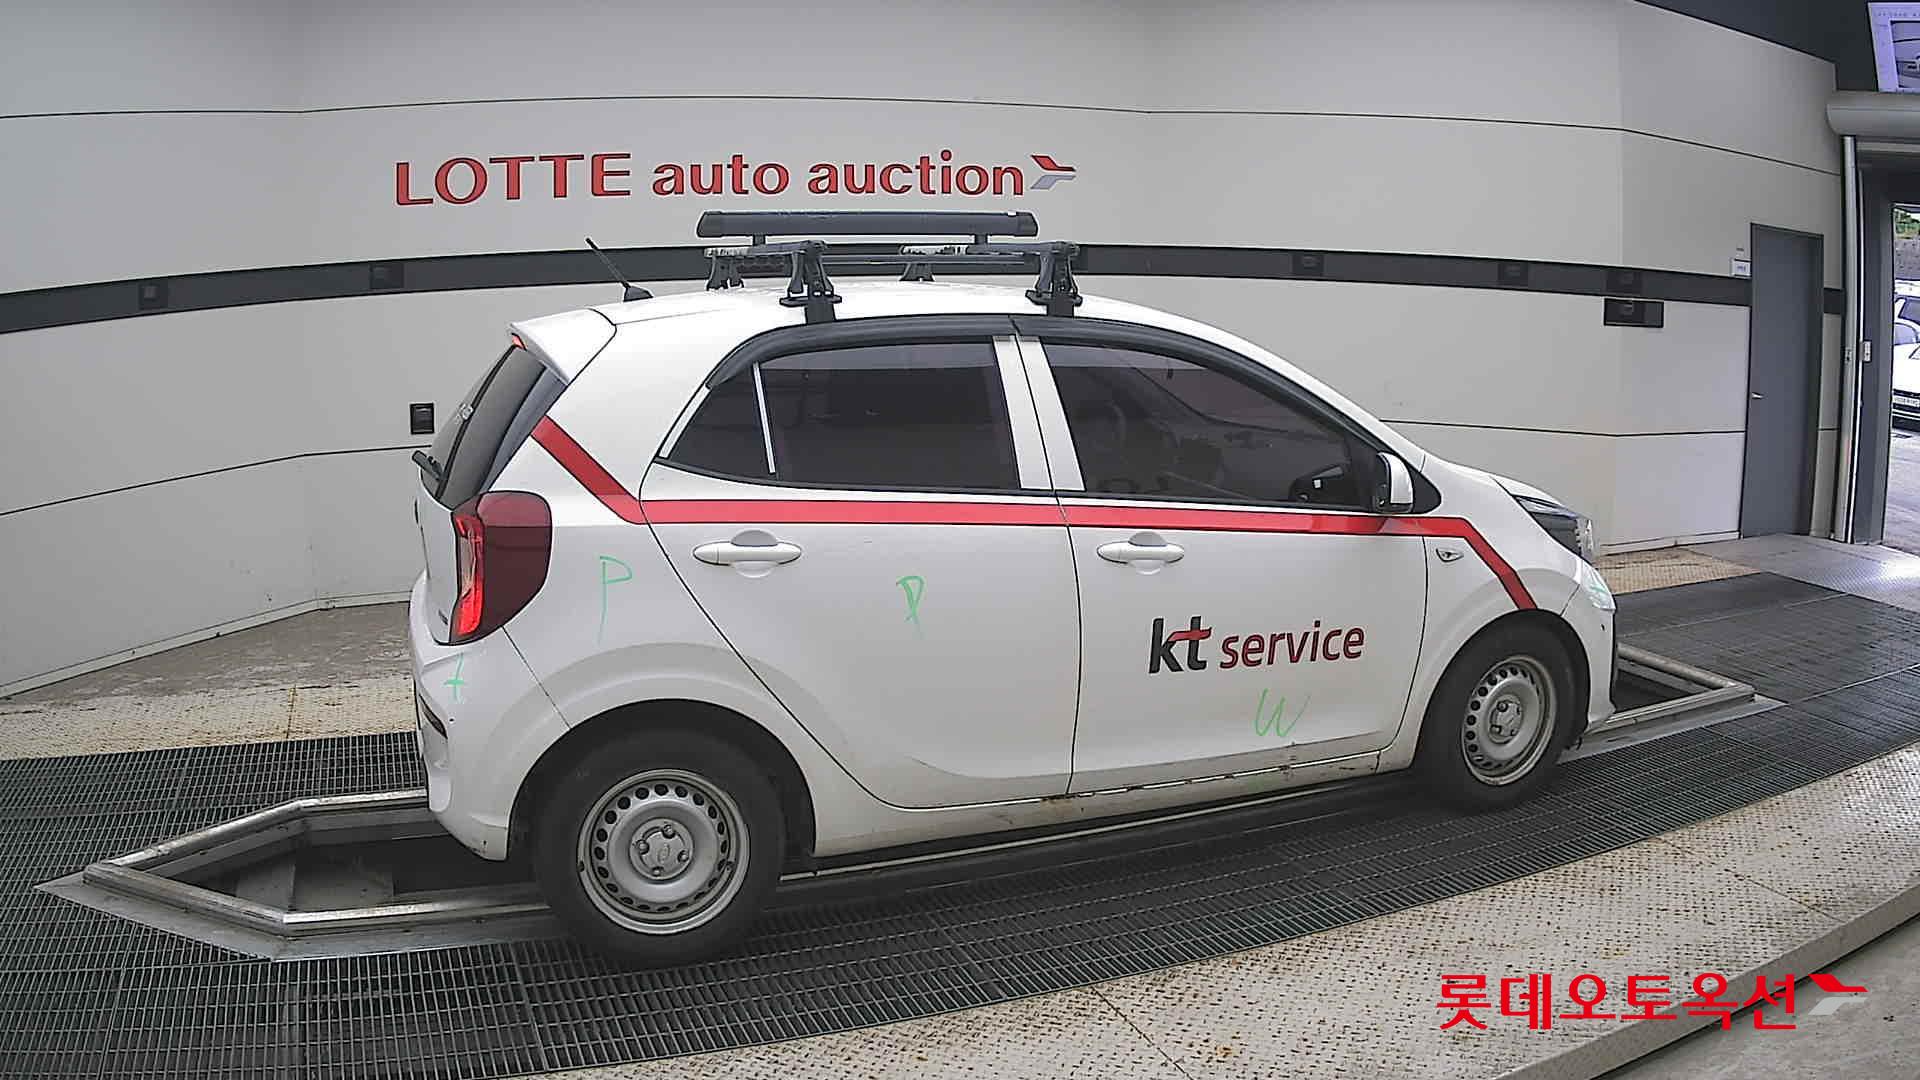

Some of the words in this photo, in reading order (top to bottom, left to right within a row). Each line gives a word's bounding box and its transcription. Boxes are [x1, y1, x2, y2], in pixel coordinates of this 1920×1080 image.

[397, 152, 631, 206] LOTTE
[653, 155, 789, 195] auto
[808, 150, 1024, 195] auction
[1149, 615, 1213, 674] kt
[1219, 620, 1366, 669] service
